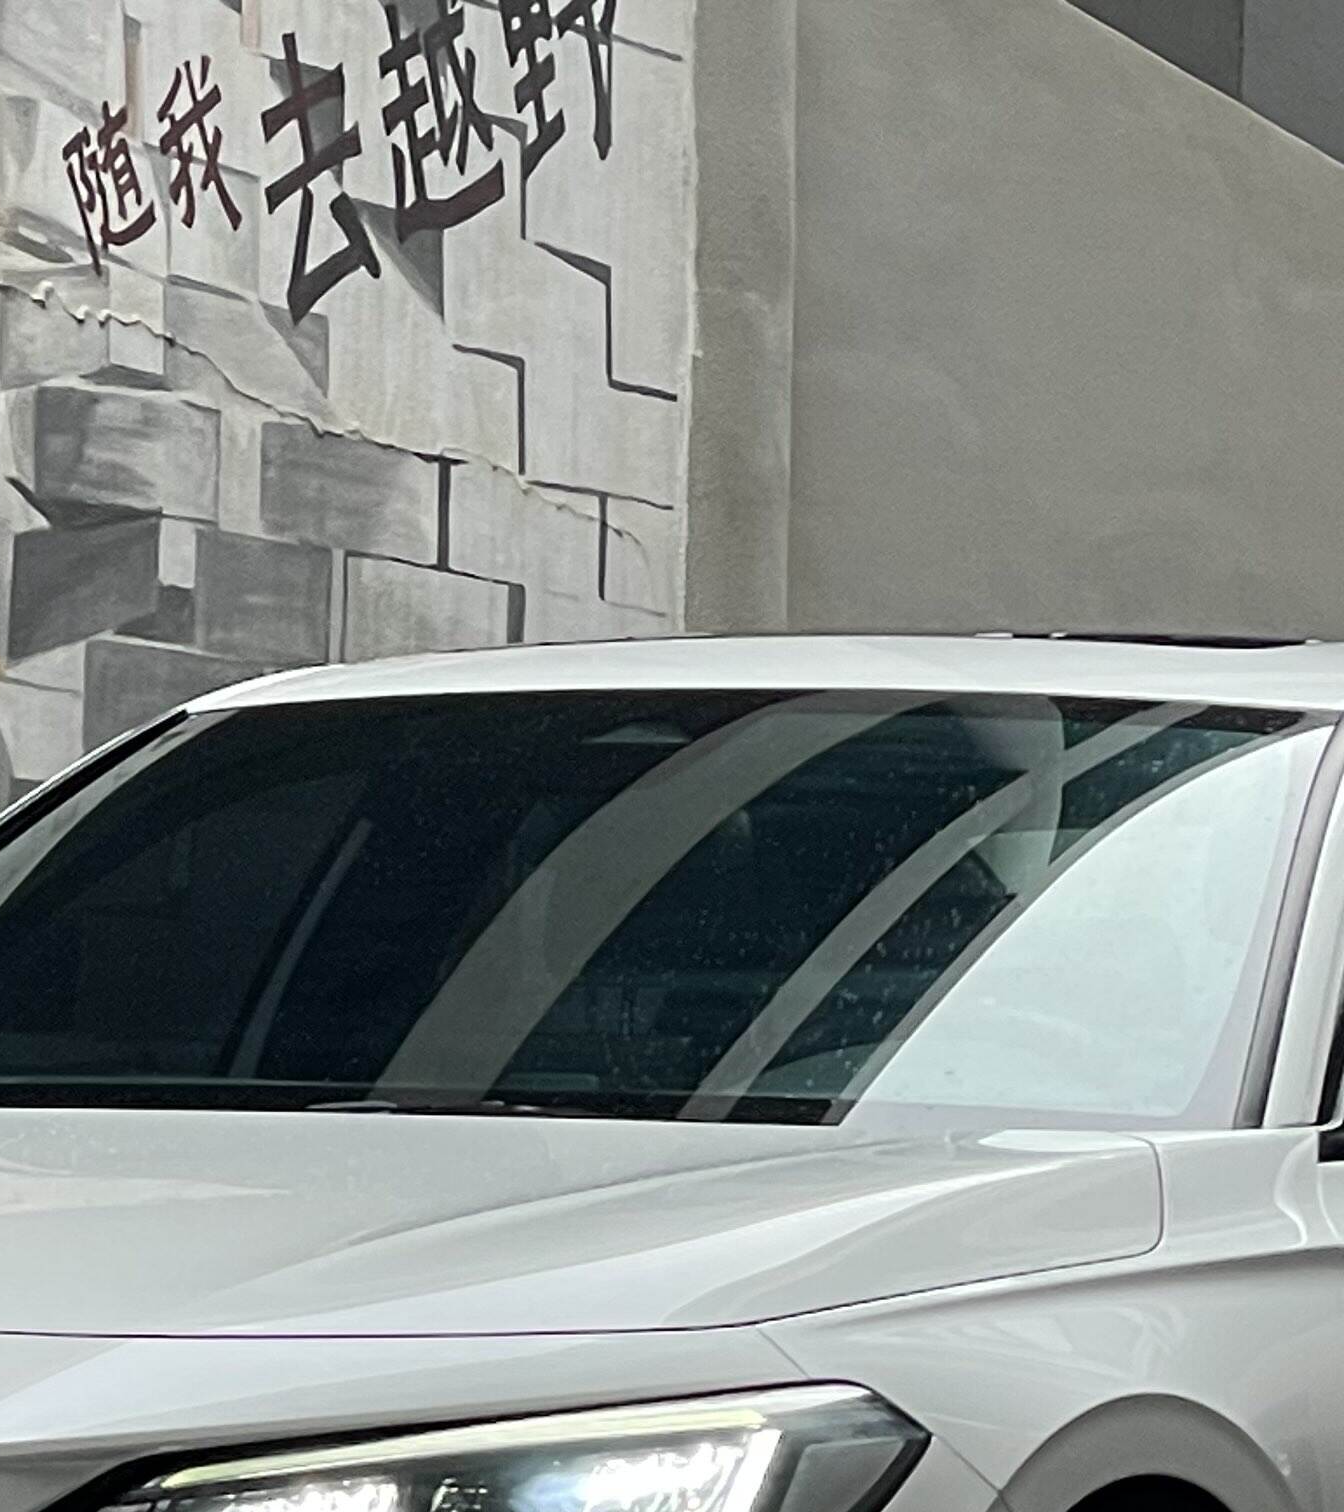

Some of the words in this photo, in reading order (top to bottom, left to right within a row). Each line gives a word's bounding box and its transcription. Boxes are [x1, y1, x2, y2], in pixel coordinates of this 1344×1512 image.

[63, 0, 615, 325] 随我去越野
